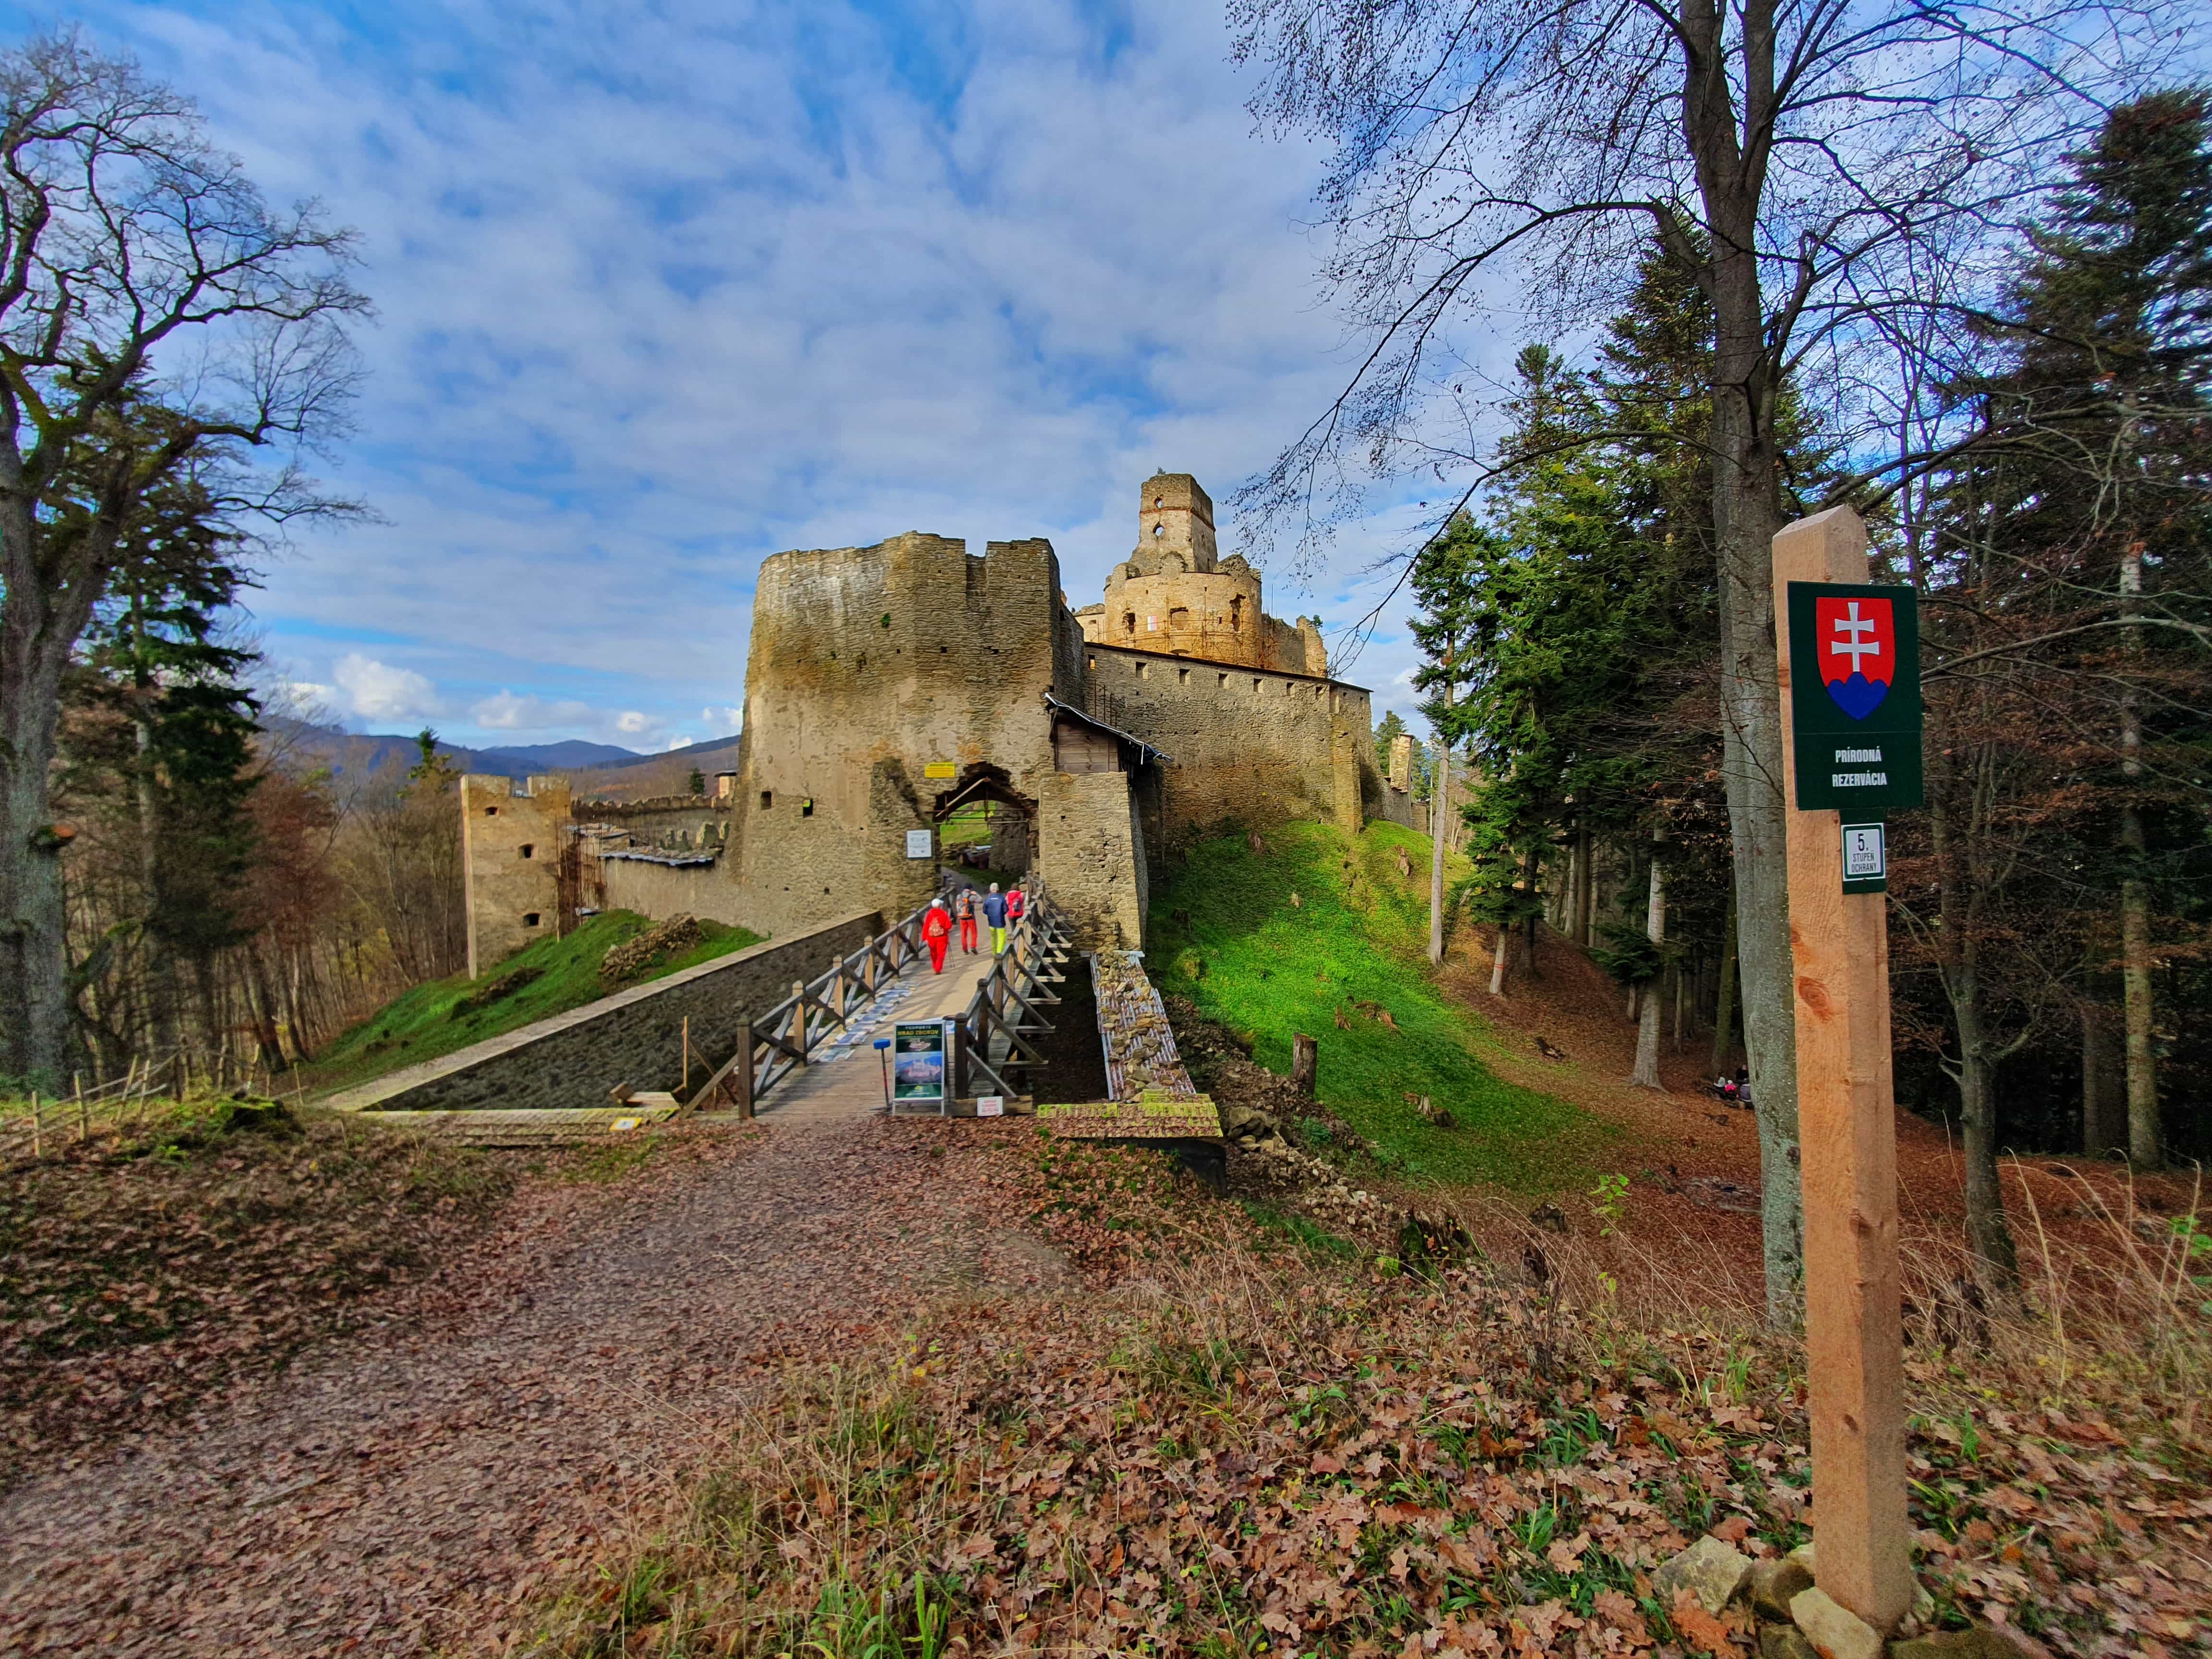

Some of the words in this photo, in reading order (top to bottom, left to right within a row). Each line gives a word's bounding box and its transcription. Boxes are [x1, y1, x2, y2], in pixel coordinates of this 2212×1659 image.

[1835, 745, 1882, 763] PRÍRODNÁ
[1832, 769, 1887, 787] REZERVÁCIA
[1858, 833, 1868, 851] 5.
[1852, 850, 1875, 862] STUPEŇ
[1851, 863, 1877, 873] OCHRANY
